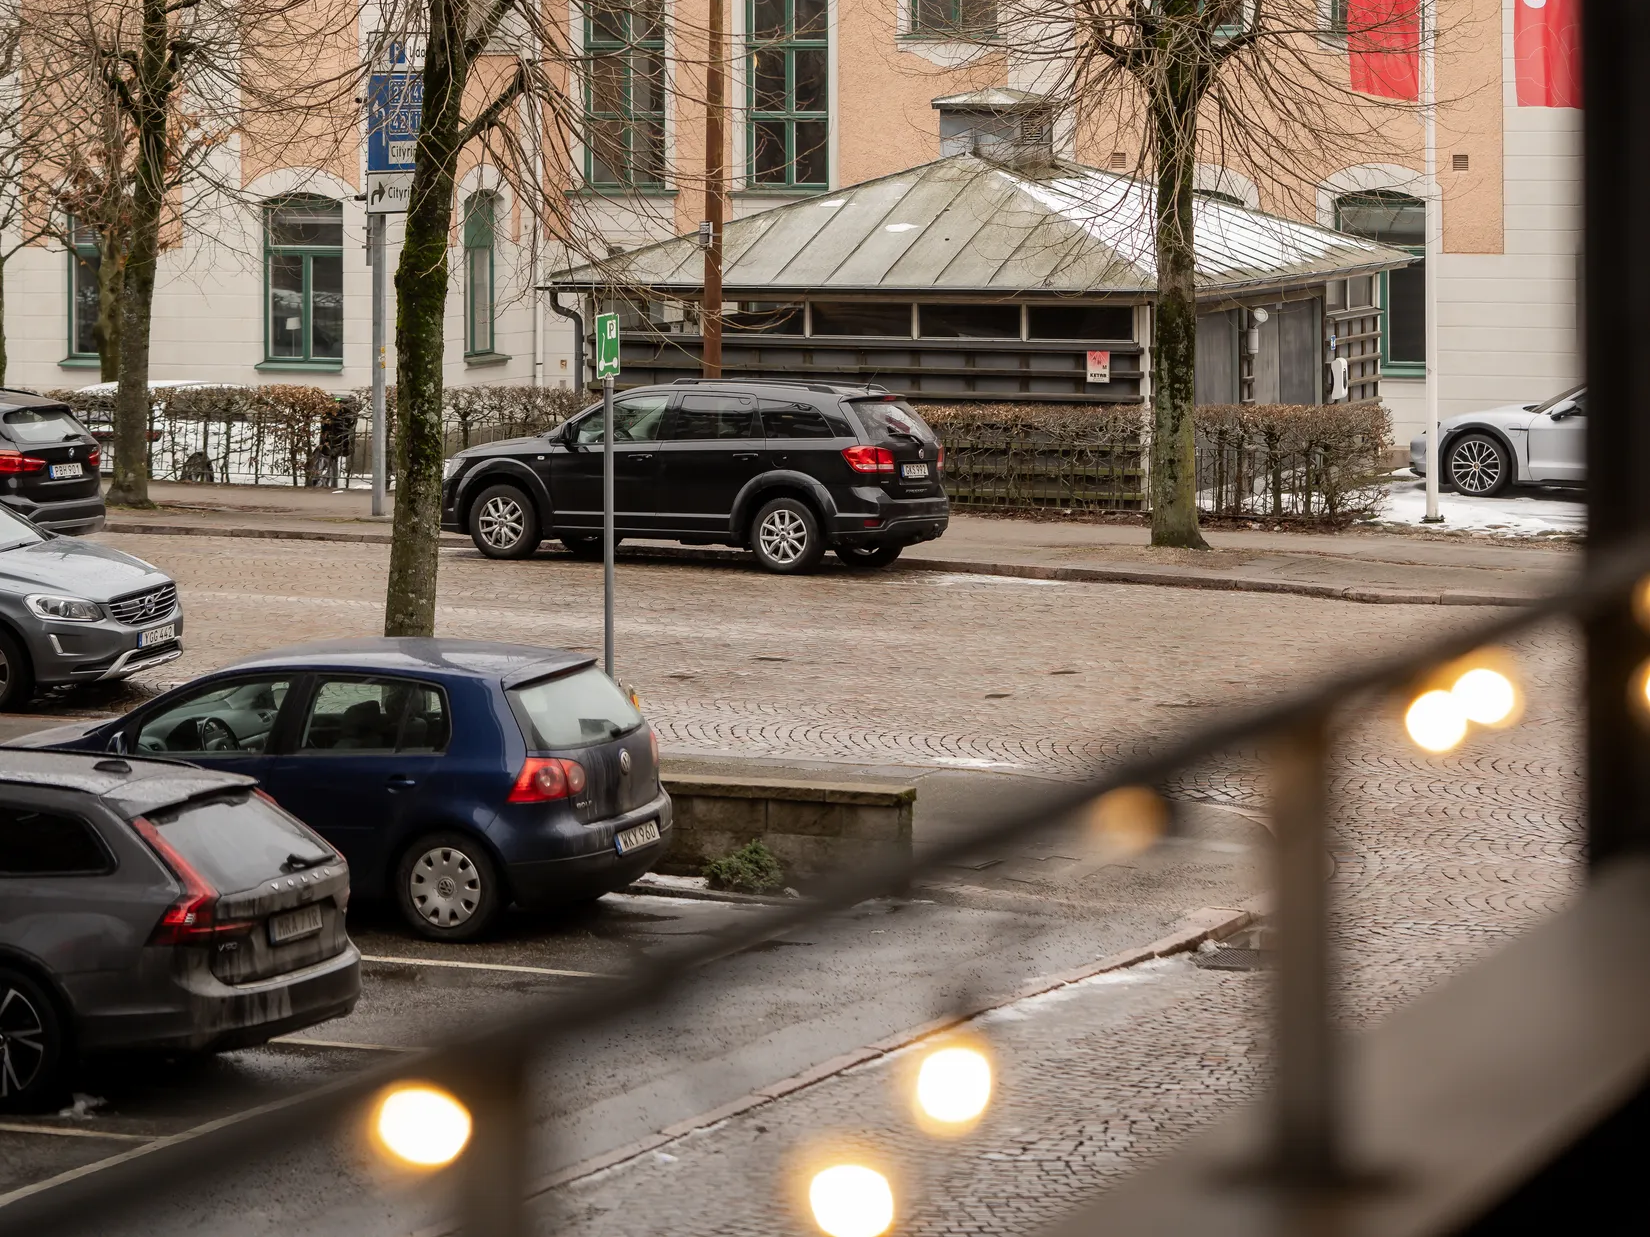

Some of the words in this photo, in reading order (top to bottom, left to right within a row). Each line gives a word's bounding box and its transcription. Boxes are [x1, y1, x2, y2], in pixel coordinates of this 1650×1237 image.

[159, 625, 172, 641] 442
[621, 829, 639, 849] WKY
[639, 822, 656, 842] 960
[270, 867, 330, 890] VOLVO
